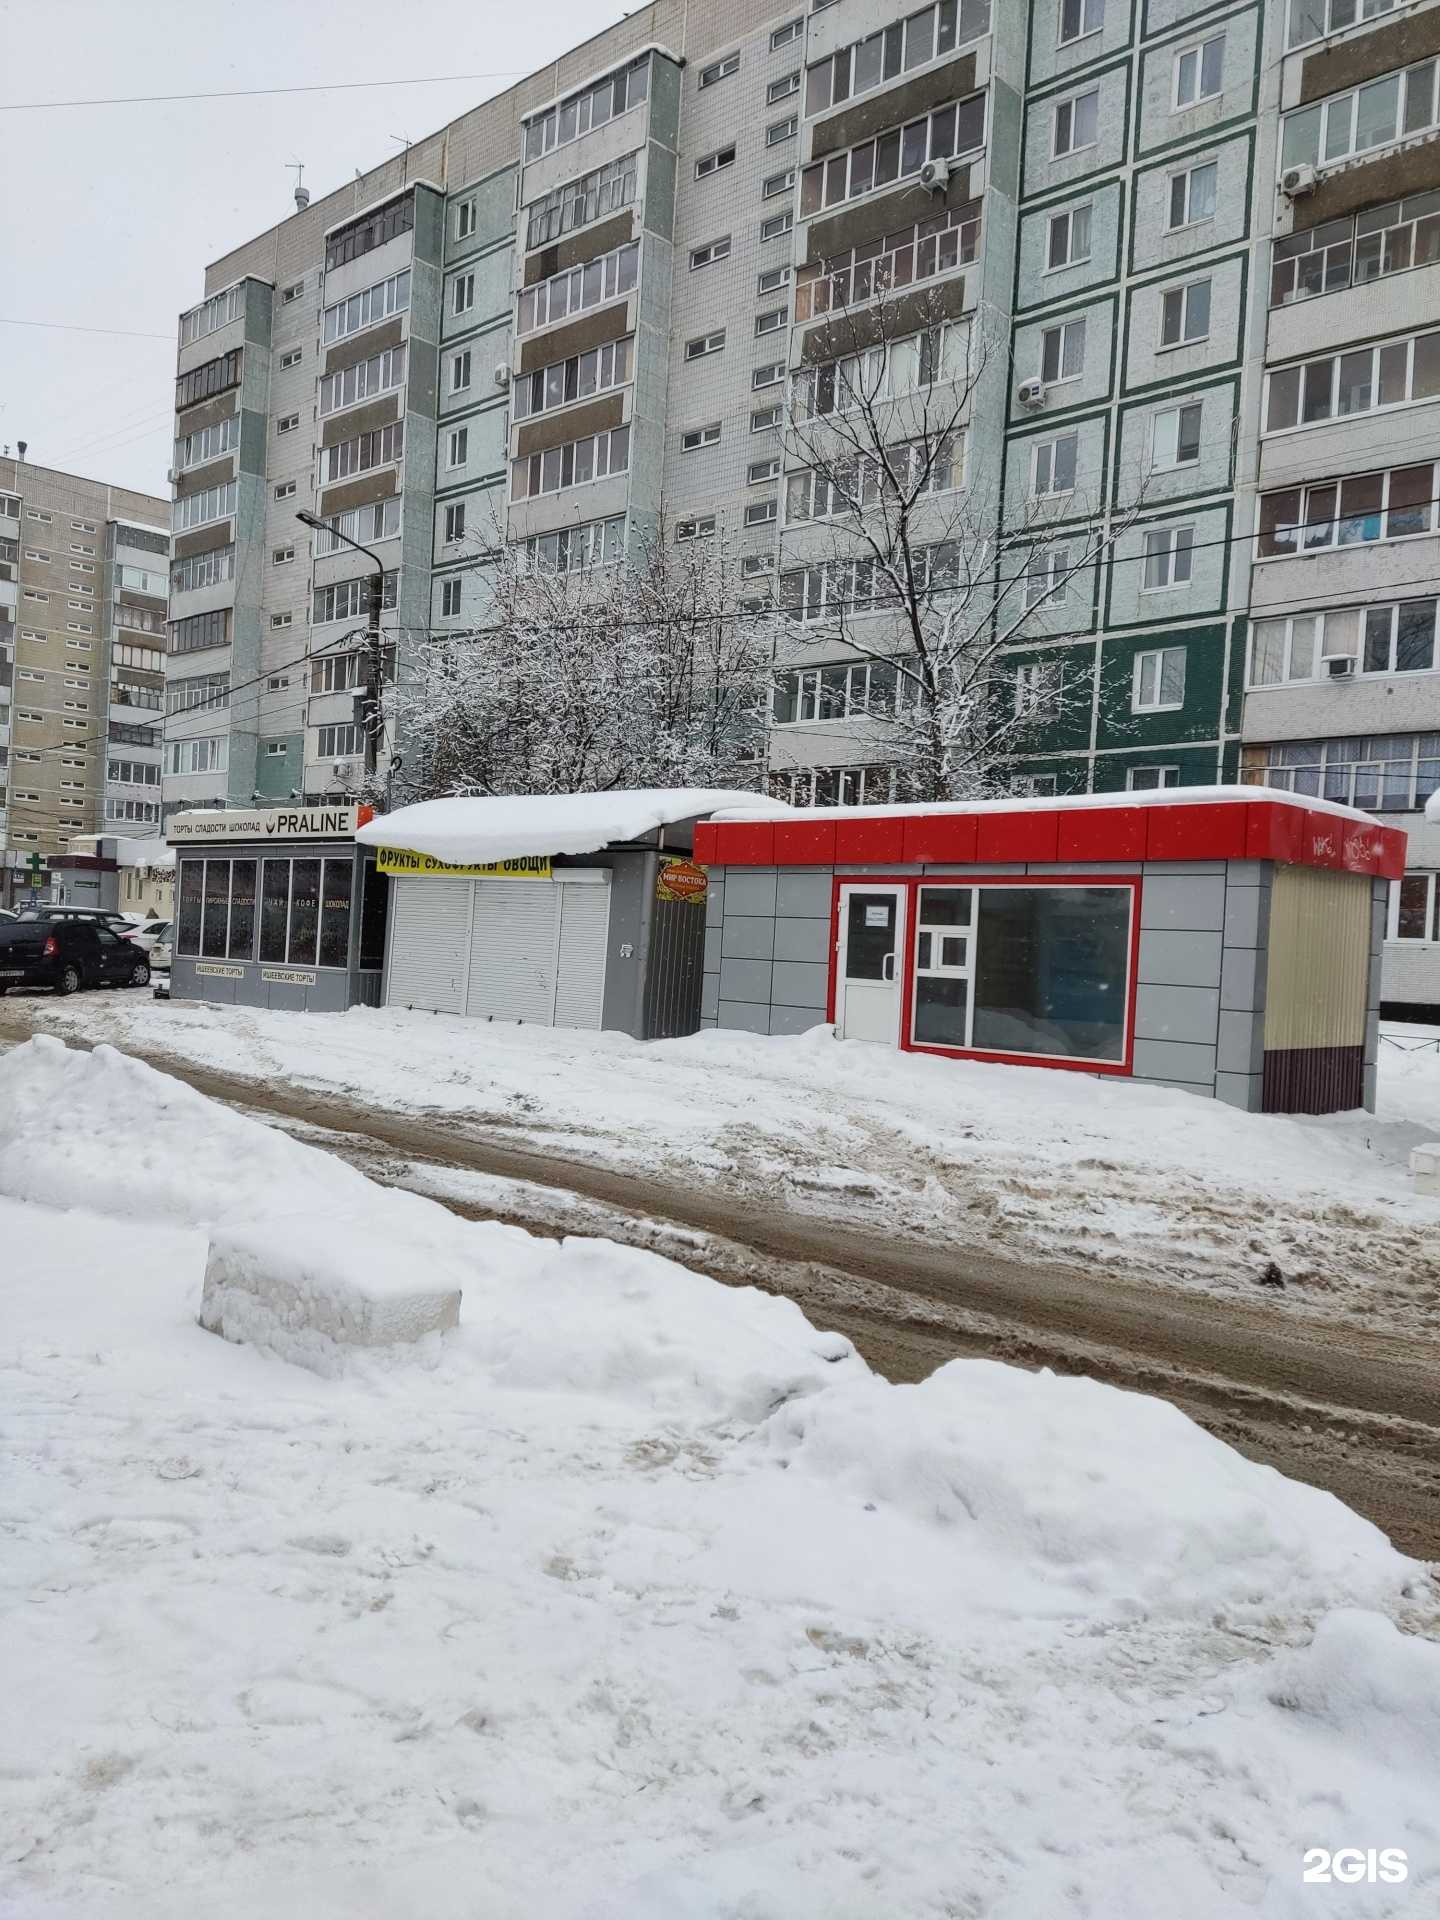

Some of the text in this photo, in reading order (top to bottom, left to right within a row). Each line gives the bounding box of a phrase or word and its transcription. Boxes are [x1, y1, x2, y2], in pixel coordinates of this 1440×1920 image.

[173, 821, 261, 834] ТОРТЫ СЛАДОСТИ ШОКОЛАД
[277, 812, 349, 833] PRALINE
[380, 849, 420, 869] ФРУКТЫ
[503, 855, 548, 875] ОВОЩИ
[663, 872, 707, 886] МИР ВОСТОКА
[296, 899, 317, 908] КОФЕ
[295, 972, 315, 983] ТОРТЫ
